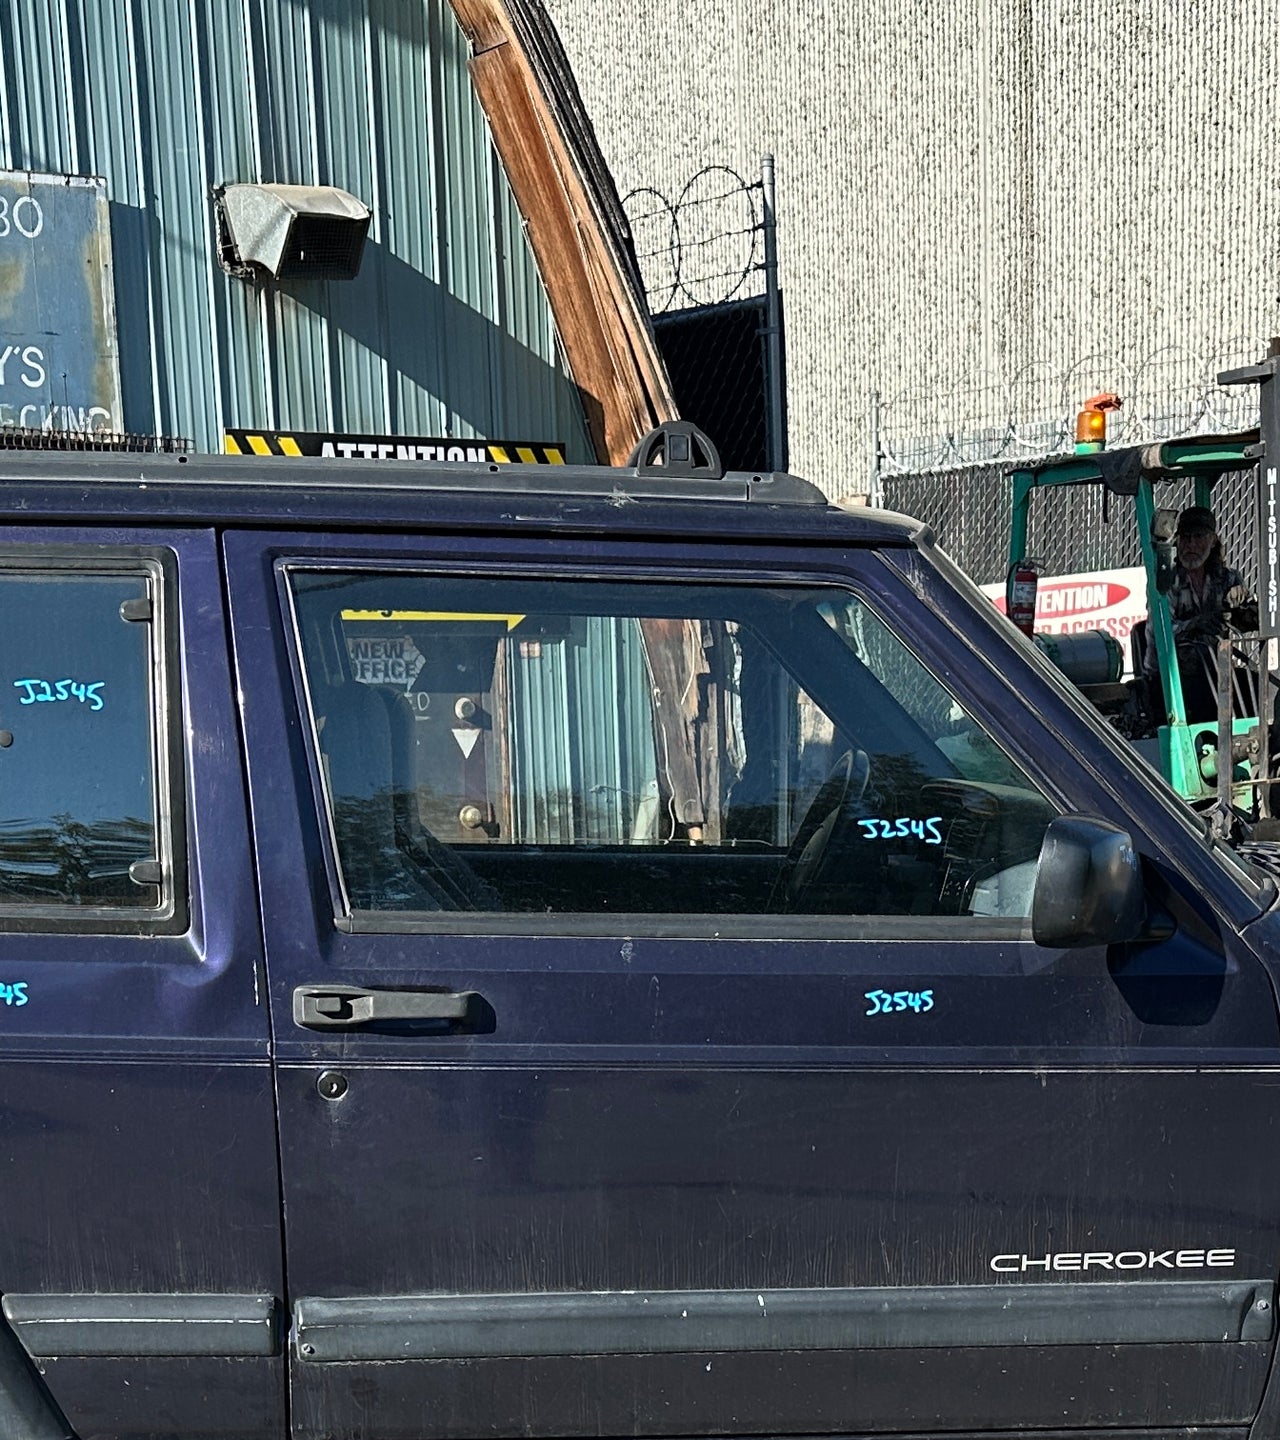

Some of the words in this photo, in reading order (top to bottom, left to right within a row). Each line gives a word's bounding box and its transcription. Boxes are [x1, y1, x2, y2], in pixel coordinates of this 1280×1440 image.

[1266, 467, 1278, 628] MITSUBISHI
[13, 679, 106, 711] J2545
[857, 817, 942, 844] J2545
[864, 989, 934, 1016] J2545
[989, 1248, 1236, 1272] CHEROKEE
